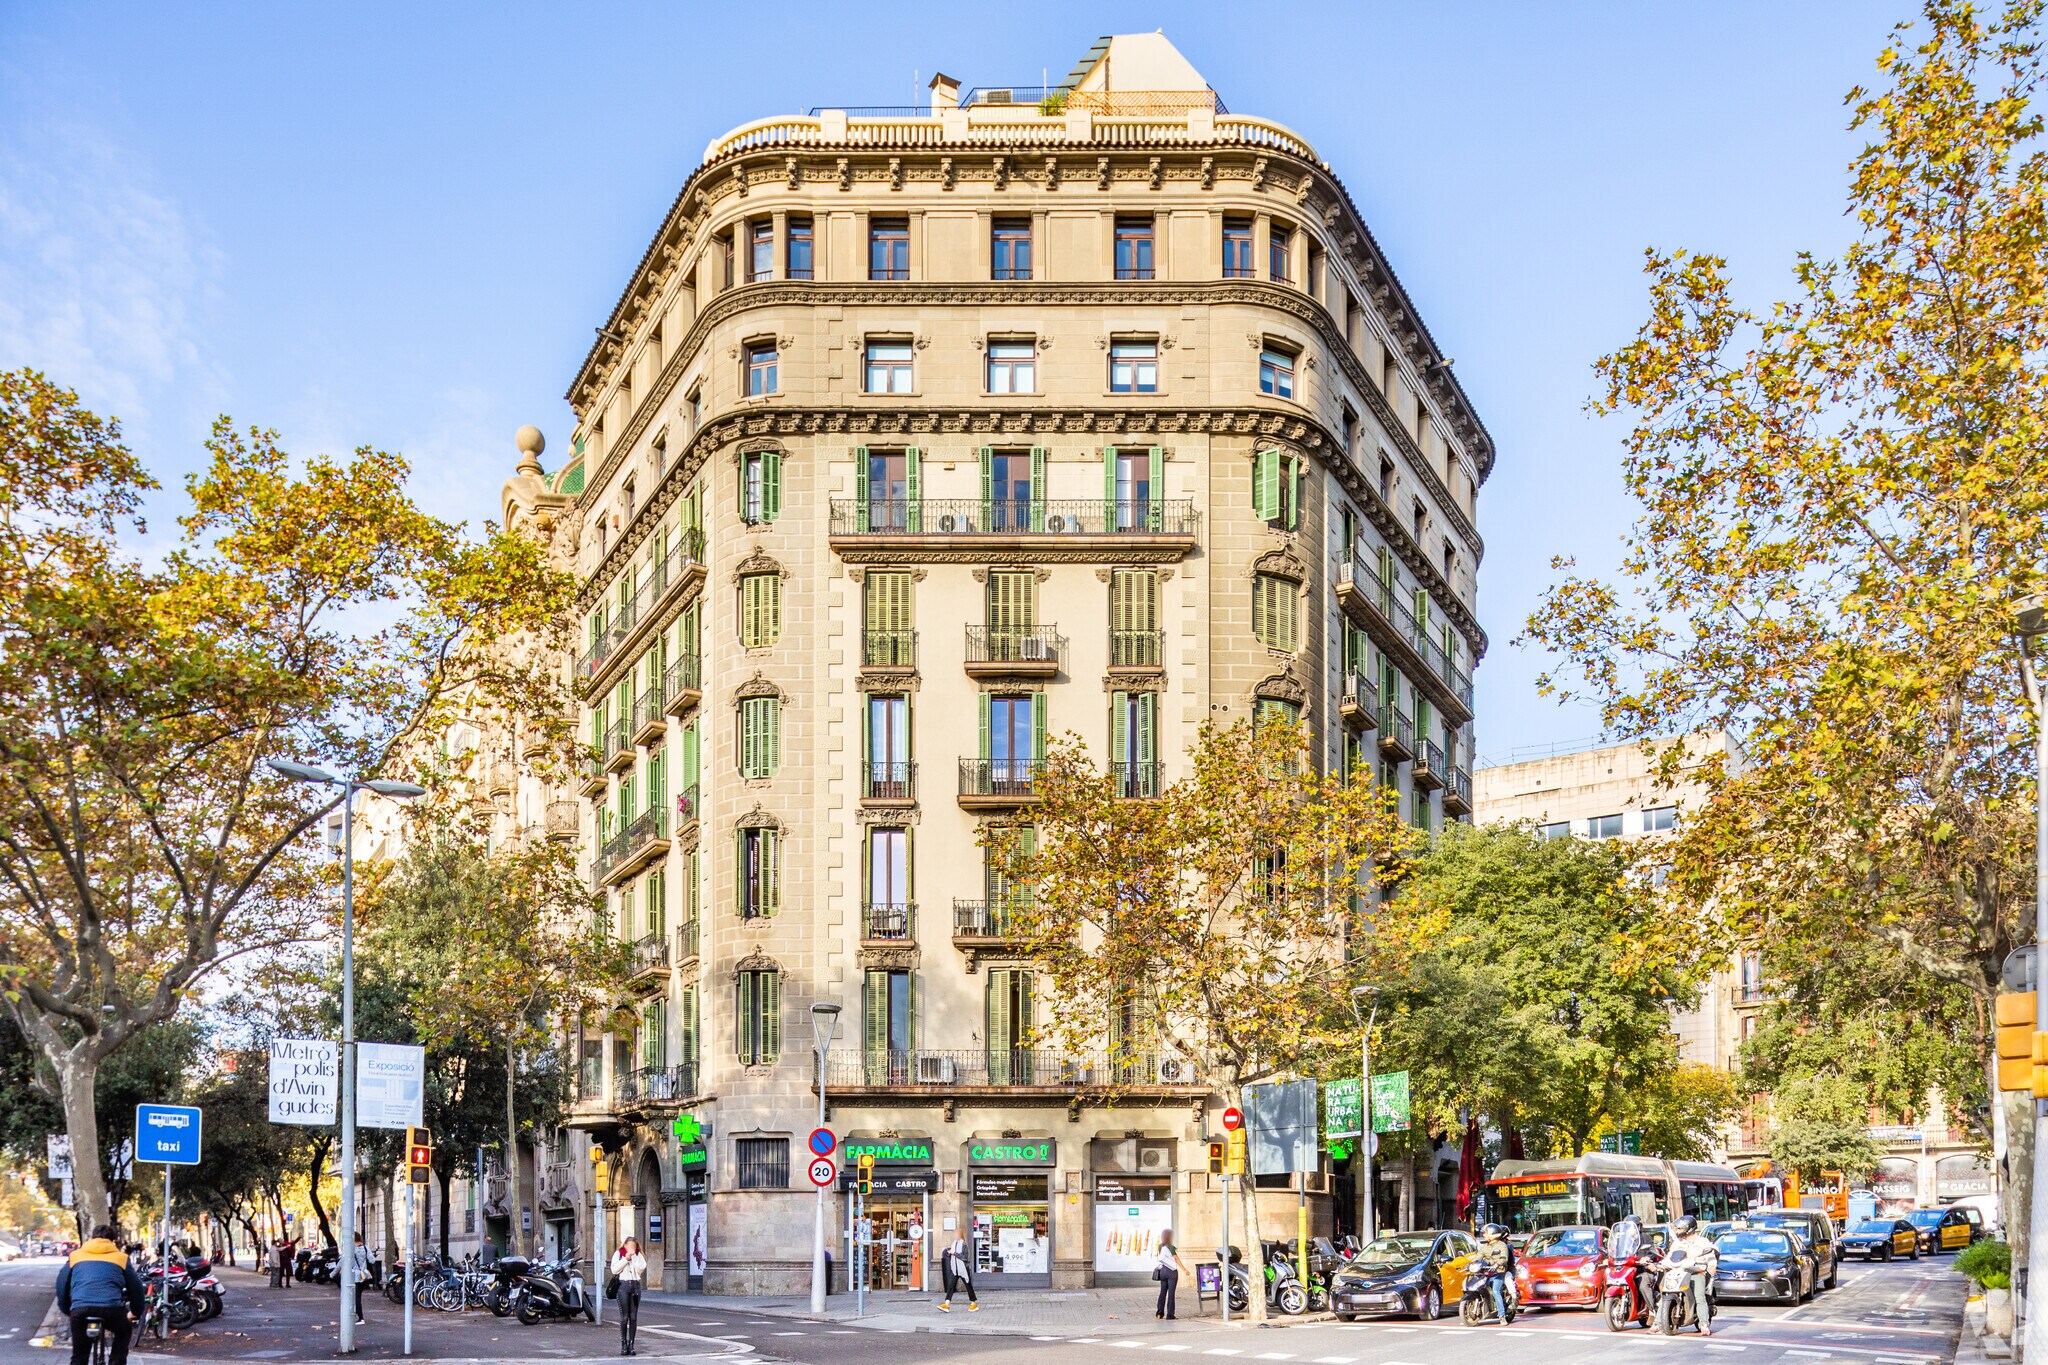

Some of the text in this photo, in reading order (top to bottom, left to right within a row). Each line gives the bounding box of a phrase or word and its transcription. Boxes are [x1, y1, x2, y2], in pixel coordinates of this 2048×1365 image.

[272, 1042, 331, 1061] Metrò
[294, 1060, 335, 1078] polis
[368, 1060, 415, 1072] Exposició
[273, 1078, 325, 1096] d'Avin
[1327, 1084, 1360, 1097] NATU-
[279, 1098, 334, 1116] gudes
[1327, 1097, 1341, 1107] RA
[1328, 1105, 1359, 1117] URBA-
[1328, 1116, 1343, 1126] NA
[157, 1140, 181, 1152] taxi
[846, 1141, 930, 1159] FARMÀCIA
[971, 1145, 1037, 1160] CASTRO
[814, 1167, 830, 1177] 20
[1498, 1181, 1567, 1198] H8 Ernest Lluch
[1872, 1185, 1910, 1194] PASSEIG
[1950, 1180, 1988, 1192] GRÀCIA
